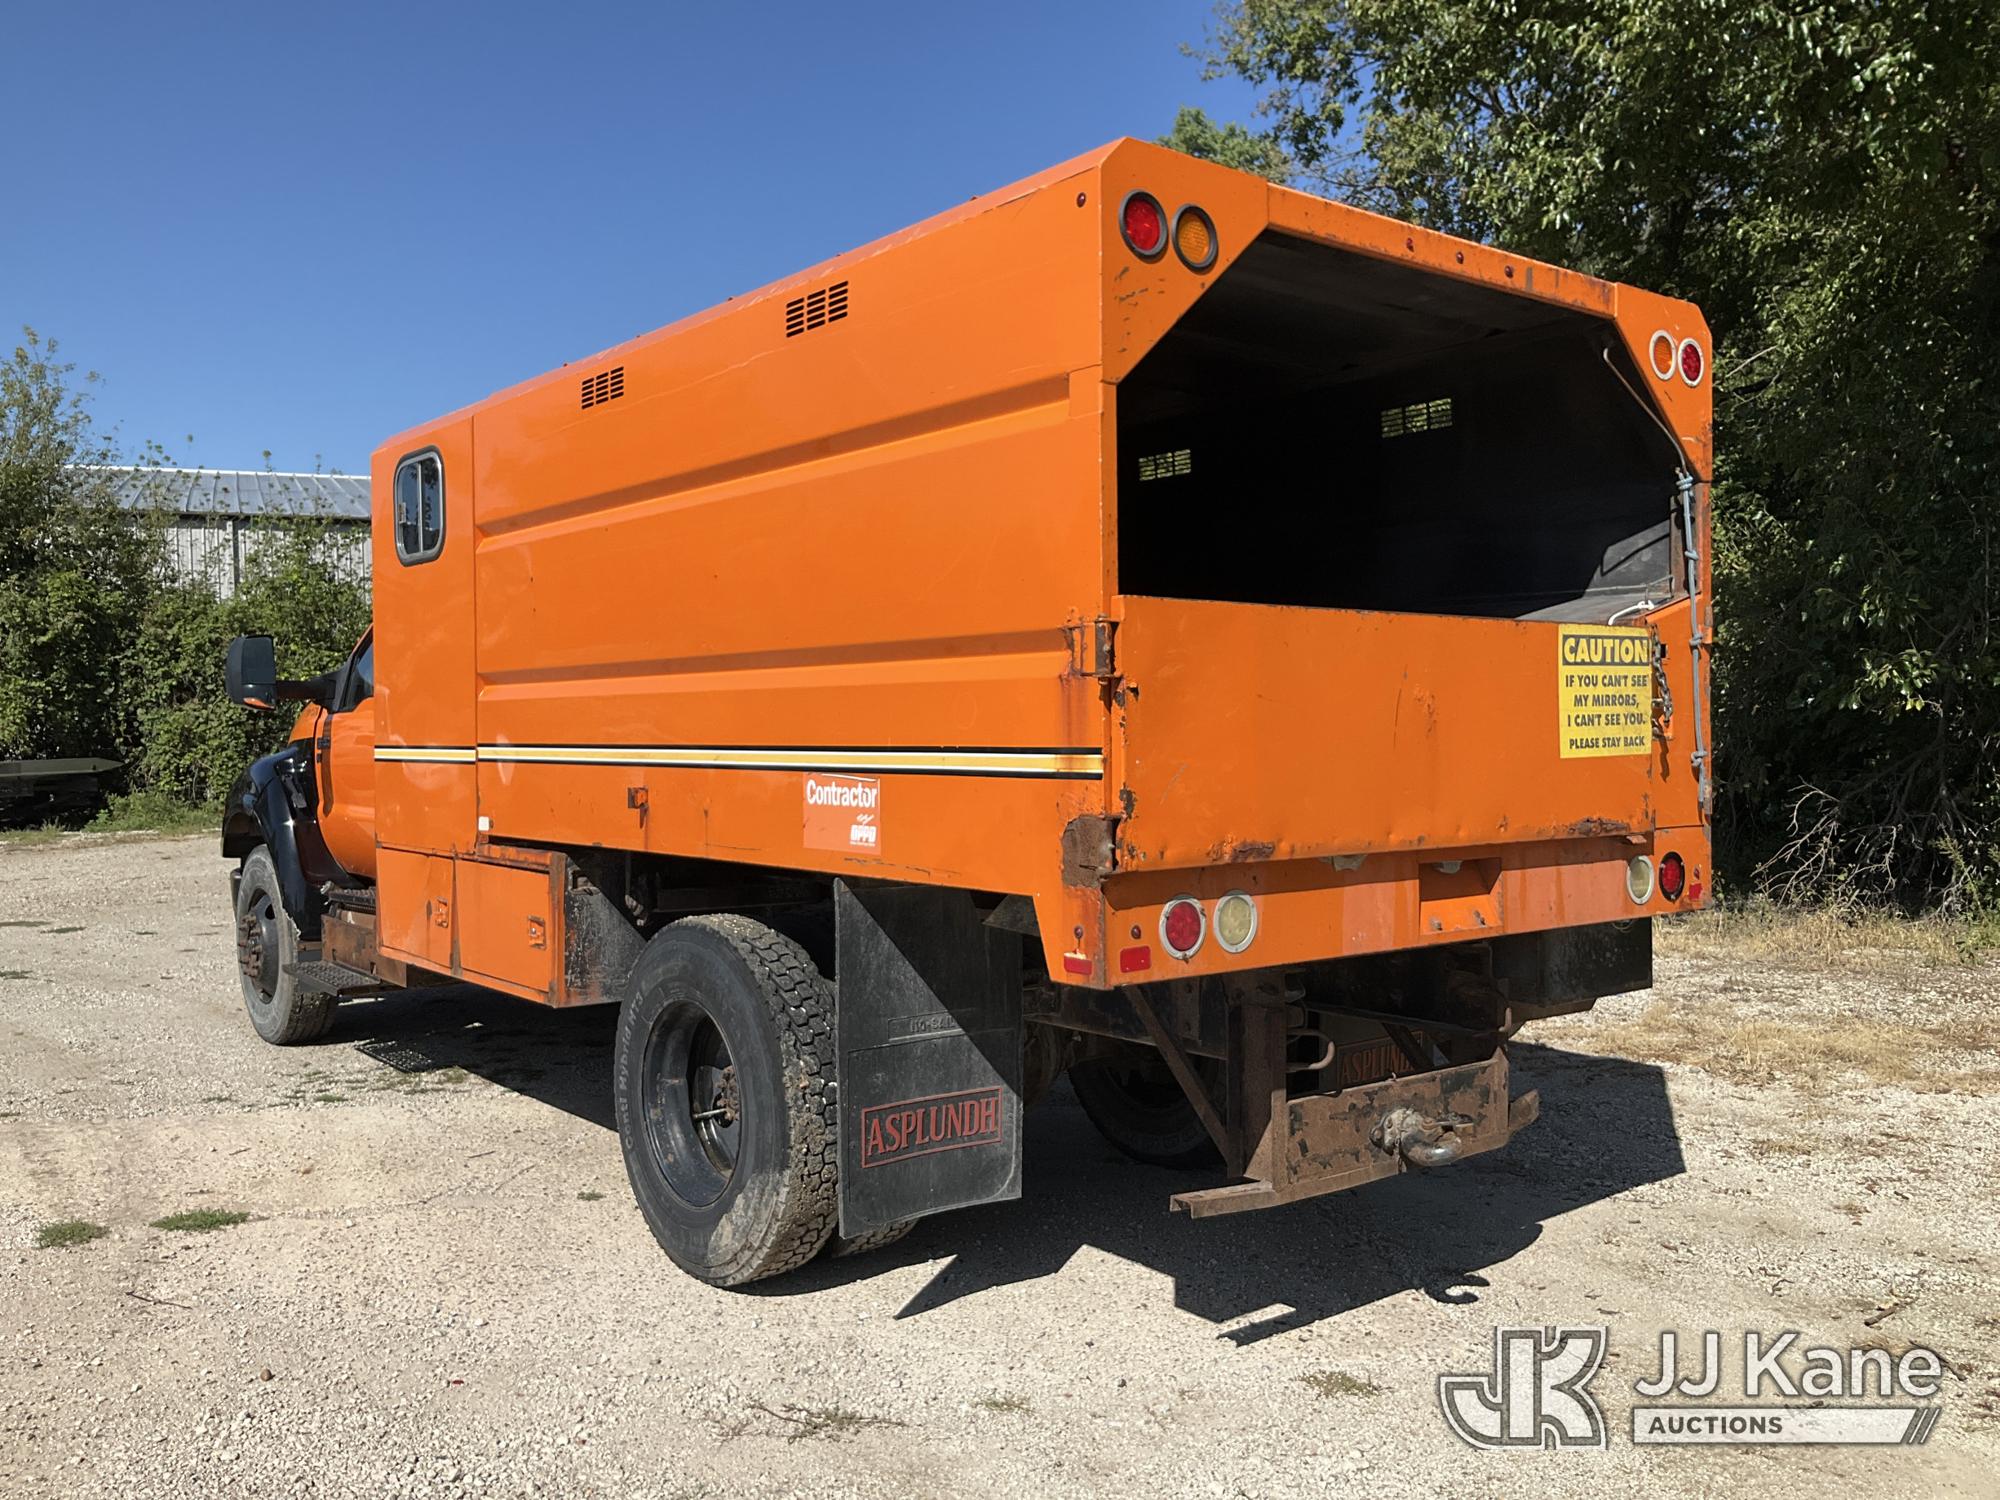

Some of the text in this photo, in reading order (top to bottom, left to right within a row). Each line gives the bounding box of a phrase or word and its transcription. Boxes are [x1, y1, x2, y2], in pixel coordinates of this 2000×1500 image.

[1564, 637, 1648, 663] CAUTION
[1565, 675, 1648, 687] IF YOU CAN'T SEE
[1574, 694, 1640, 708] MY MIRRORS,
[1574, 714, 1602, 726] CAN'T
[1604, 714, 1620, 726] SEE
[1623, 713, 1646, 725] YOU.
[1569, 735, 1645, 749] PLEASE STAY BACK
[806, 779, 877, 808] Contractor
[867, 1097, 998, 1157] ASPLUNDH
